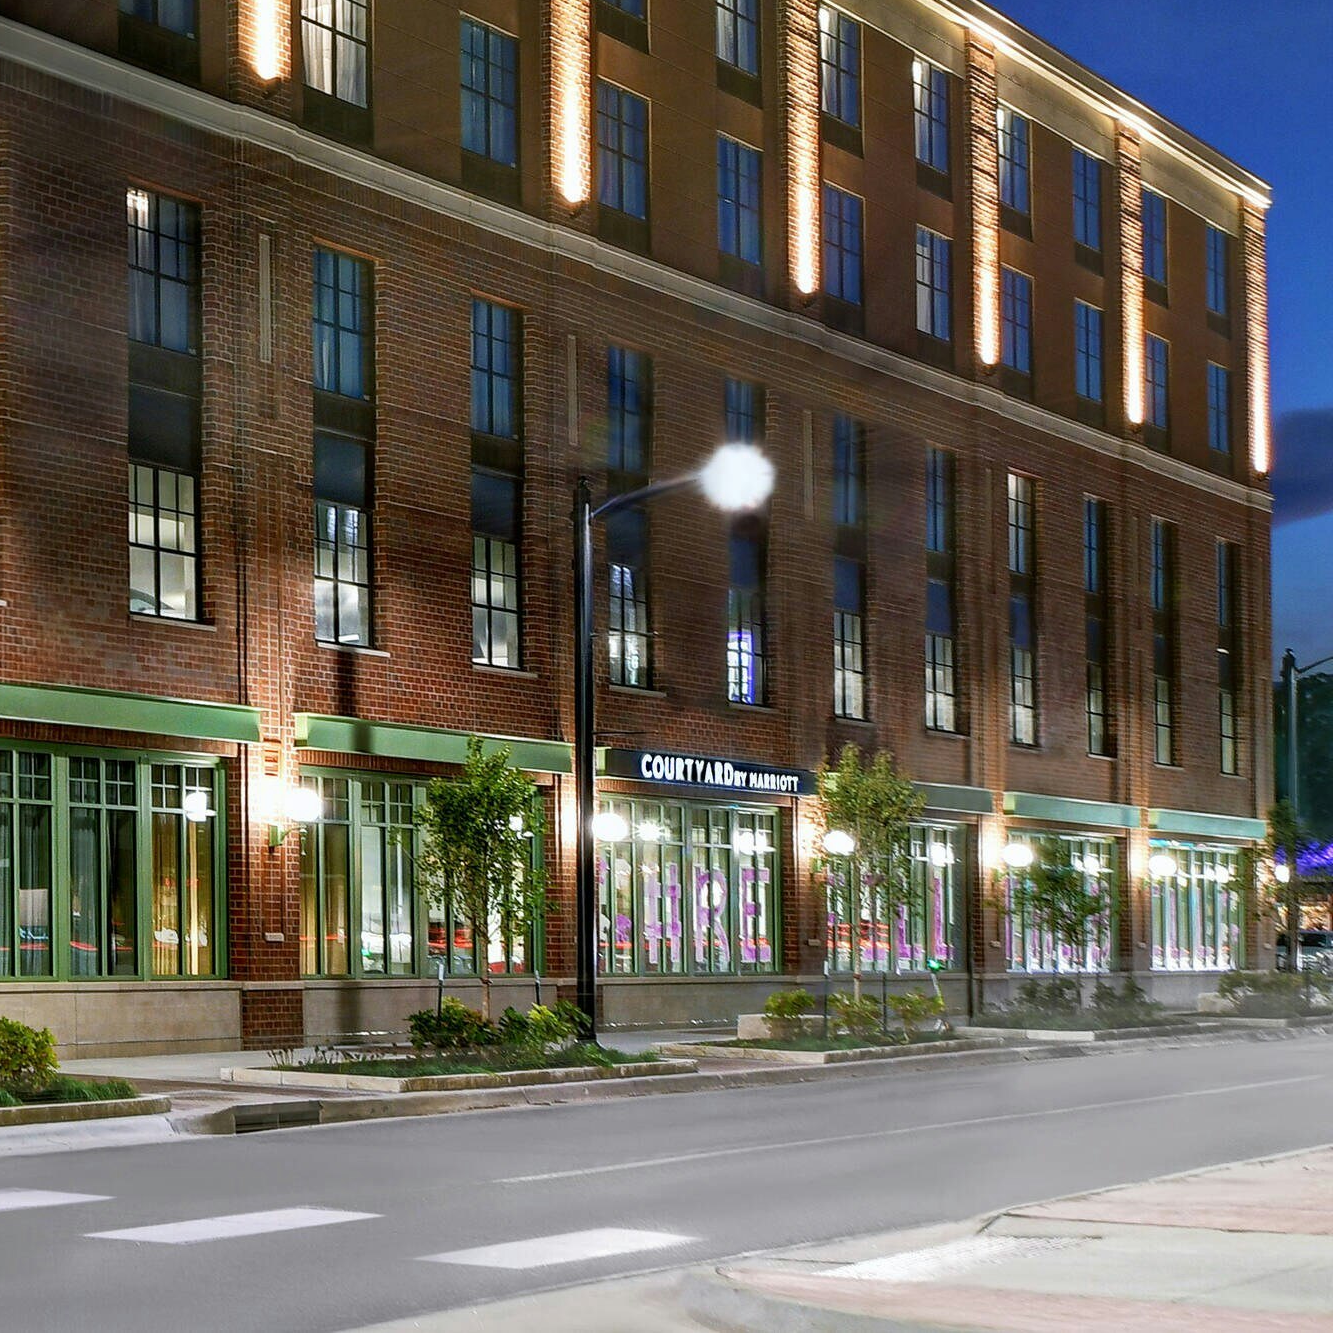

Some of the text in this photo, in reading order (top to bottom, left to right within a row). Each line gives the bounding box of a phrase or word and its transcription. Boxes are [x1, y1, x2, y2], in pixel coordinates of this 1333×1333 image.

[641, 753, 799, 792] COURTYARD BY MARRIOTT
